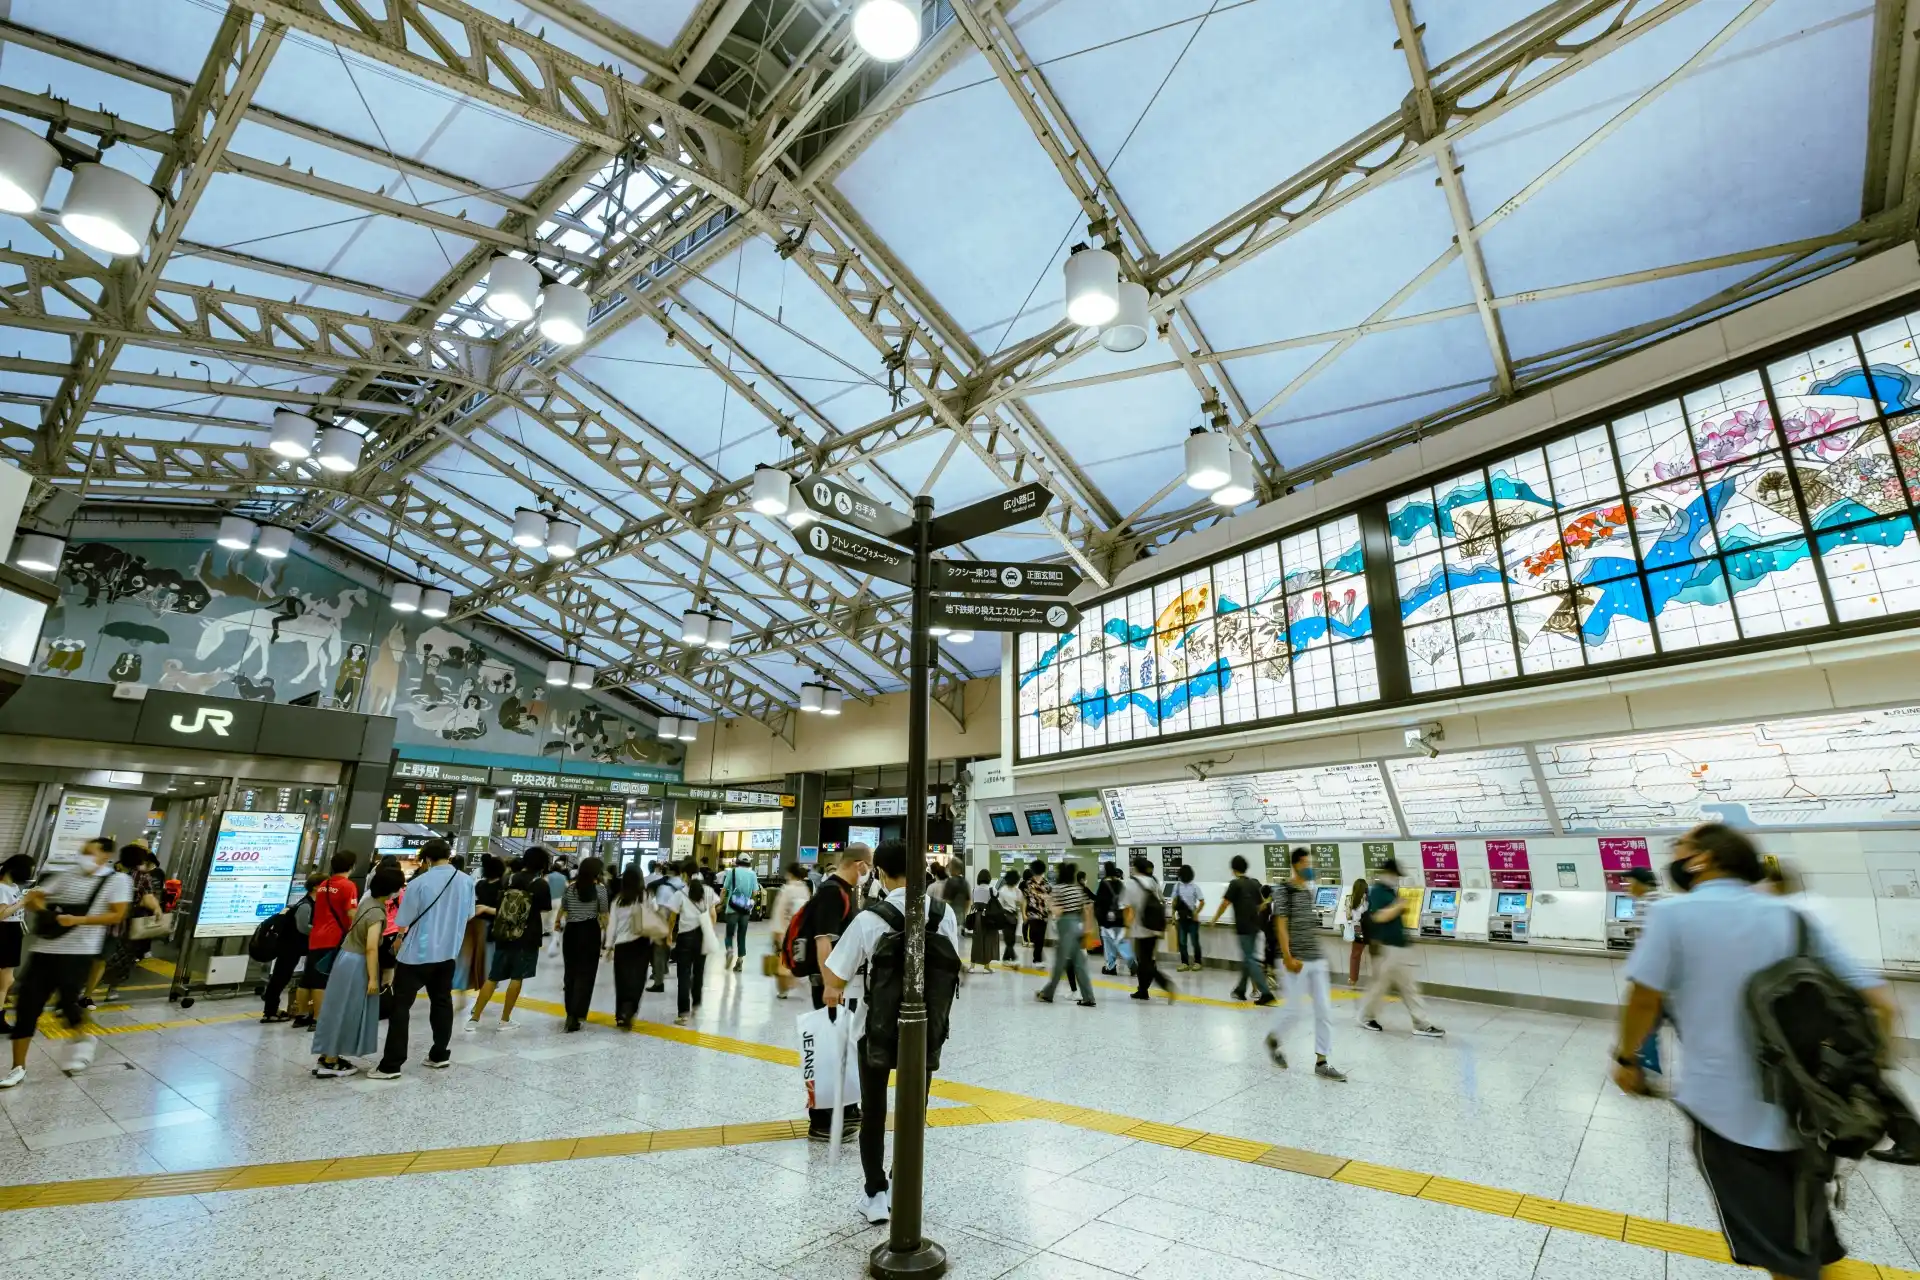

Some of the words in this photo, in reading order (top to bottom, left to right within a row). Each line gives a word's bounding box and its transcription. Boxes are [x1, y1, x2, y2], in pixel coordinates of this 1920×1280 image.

[1003, 491, 1036, 510] 広小路口
[855, 502, 876, 518] お手洗
[832, 535, 850, 548] アトレ
[851, 543, 900, 566] インフォメーション
[832, 546, 854, 558] Information
[854, 553, 867, 562] Center
[948, 568, 998, 578] タクシー乗り場
[1026, 570, 1063, 580] 正面玄関口
[945, 604, 1043, 616] 地下鉄乗り換えエスカレーター
[170, 708, 234, 736] JR
[396, 762, 440, 778] 上野駅
[461, 774, 485, 782] Station
[512, 772, 557, 788] 中央改札
[690, 789, 710, 799] 新幹線
[1487, 842, 1526, 851] チャージ専用
[1600, 840, 1646, 850] チャージ専用
[216, 851, 260, 862] 2,000
[803, 1031, 814, 1080] JEANS
